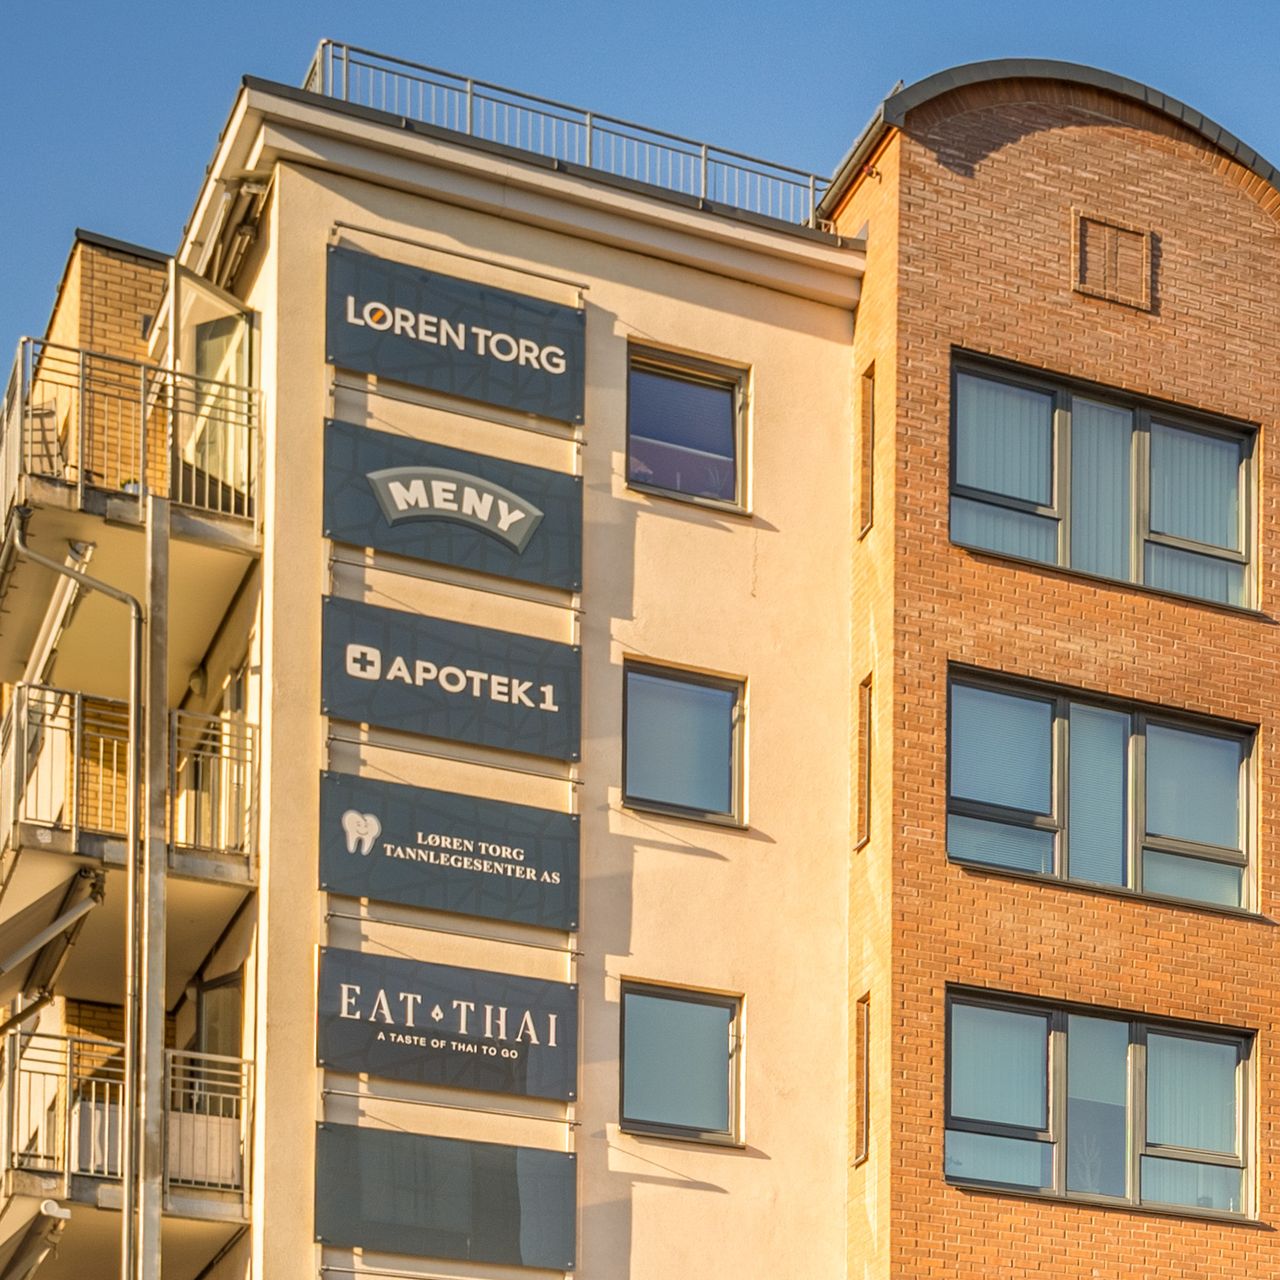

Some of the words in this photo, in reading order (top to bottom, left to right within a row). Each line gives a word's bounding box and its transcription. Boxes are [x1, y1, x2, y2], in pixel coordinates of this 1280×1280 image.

[471, 327, 567, 375] TORG
[388, 479, 526, 532] MENY
[383, 843, 537, 881] TANNLEGESENTER
[540, 871, 561, 884] AS
[416, 831, 474, 853] LØREN
[478, 842, 525, 862] TORG
[339, 983, 422, 1027] EAT
[452, 1000, 558, 1047] THAI
[377, 1031, 386, 1041] A
[389, 1033, 427, 1047] TASTE
[430, 1038, 447, 1049] OF
[450, 1041, 478, 1054] THAI
[481, 1045, 497, 1056] TO
[501, 1048, 518, 1059] GO
